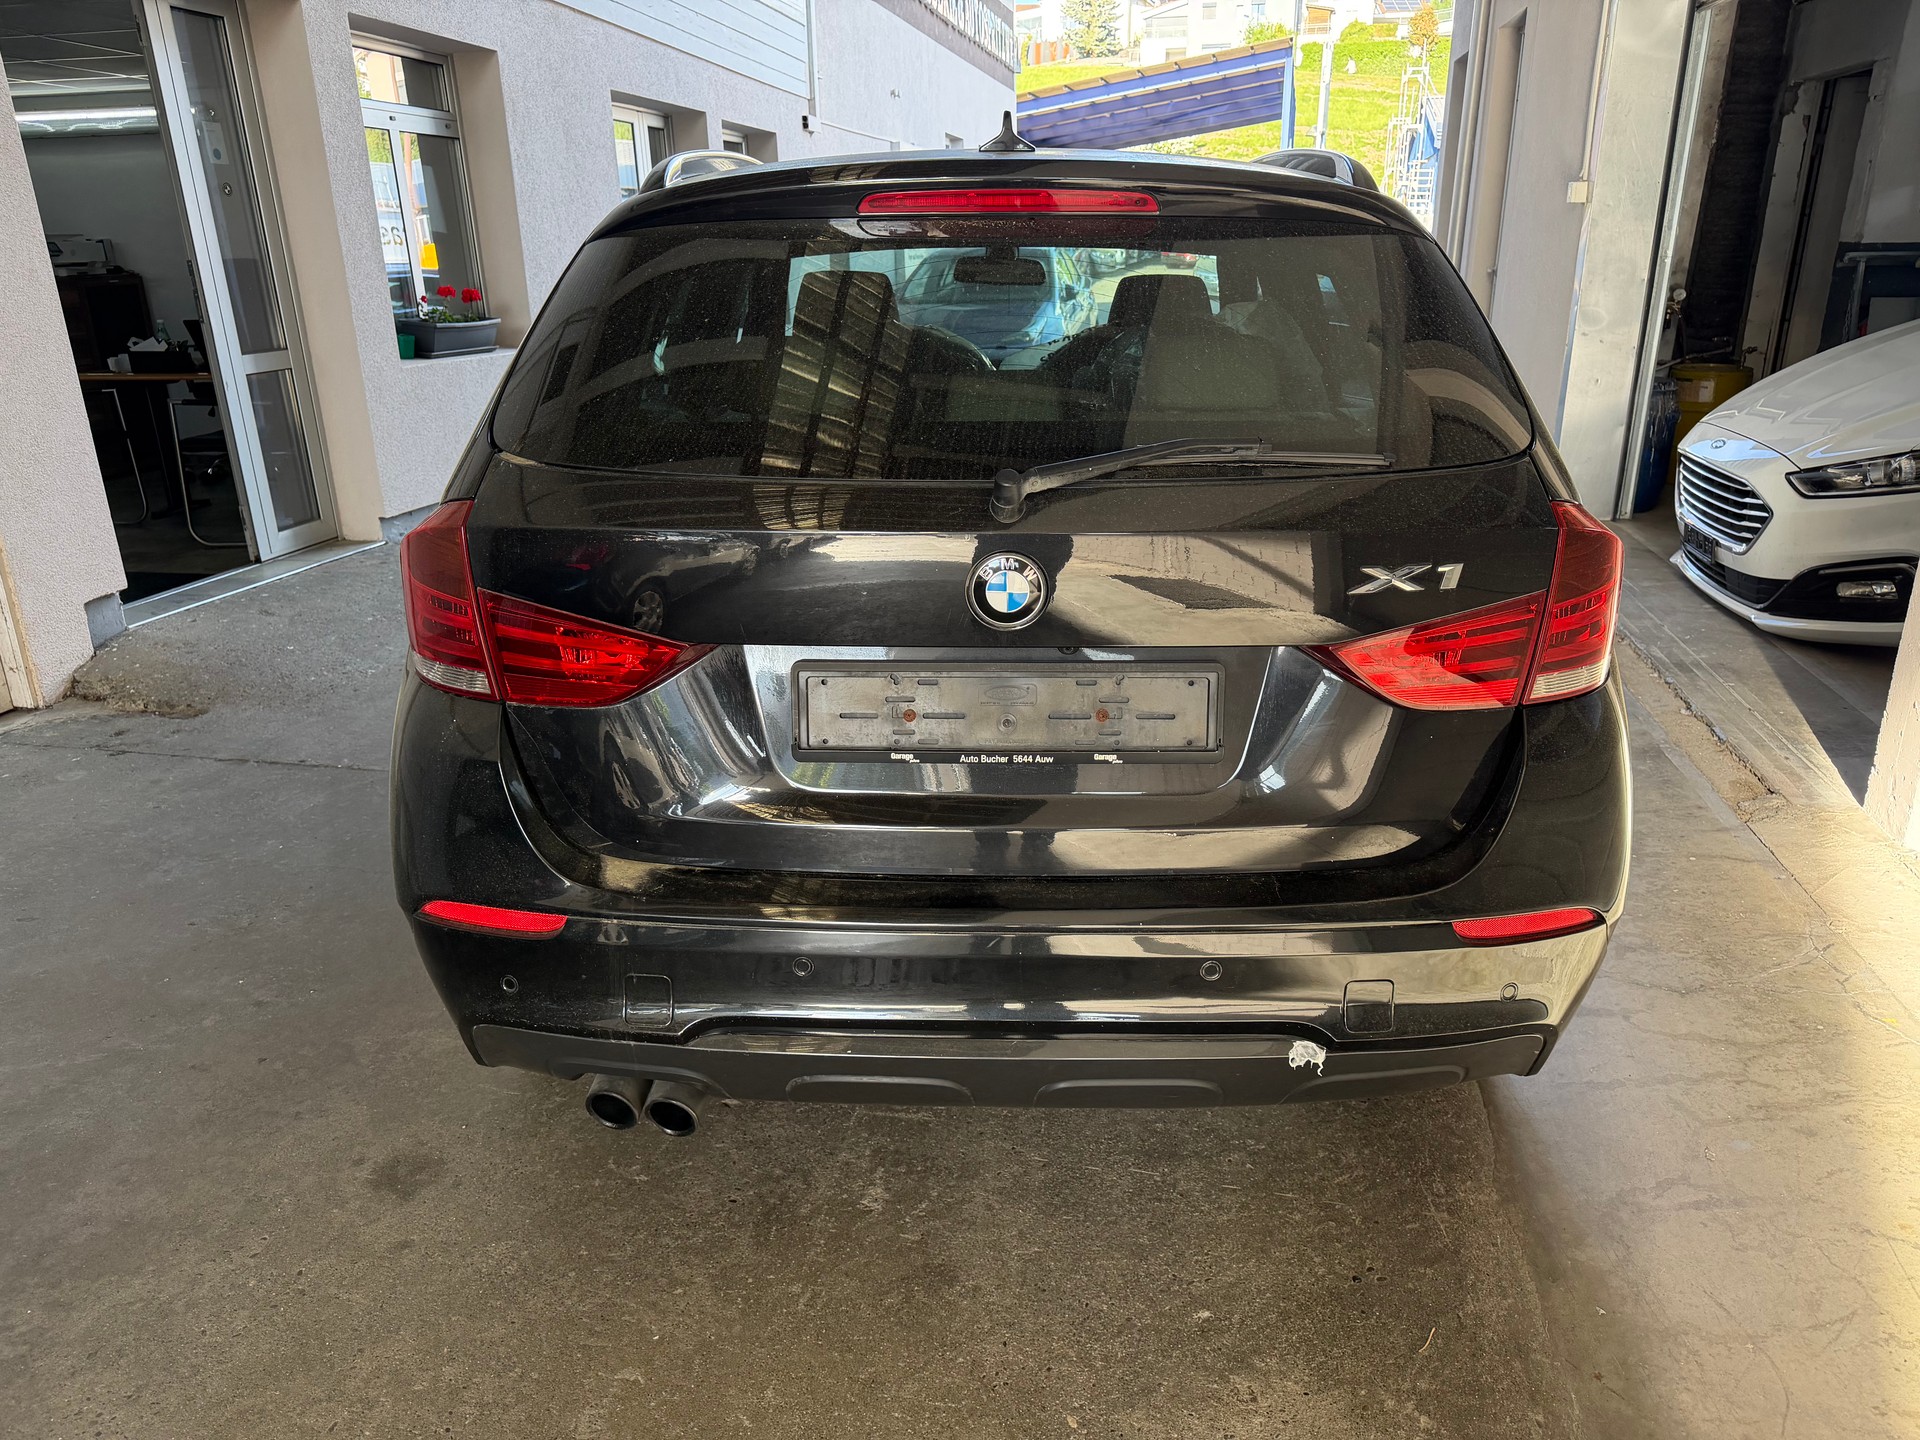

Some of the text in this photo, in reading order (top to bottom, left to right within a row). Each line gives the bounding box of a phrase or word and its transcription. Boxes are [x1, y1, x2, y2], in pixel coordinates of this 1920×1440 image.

[978, 558, 1037, 581] BMW
[1346, 562, 1464, 594] X1
[959, 754, 1054, 763] Auto Bucher 5644 Auw
